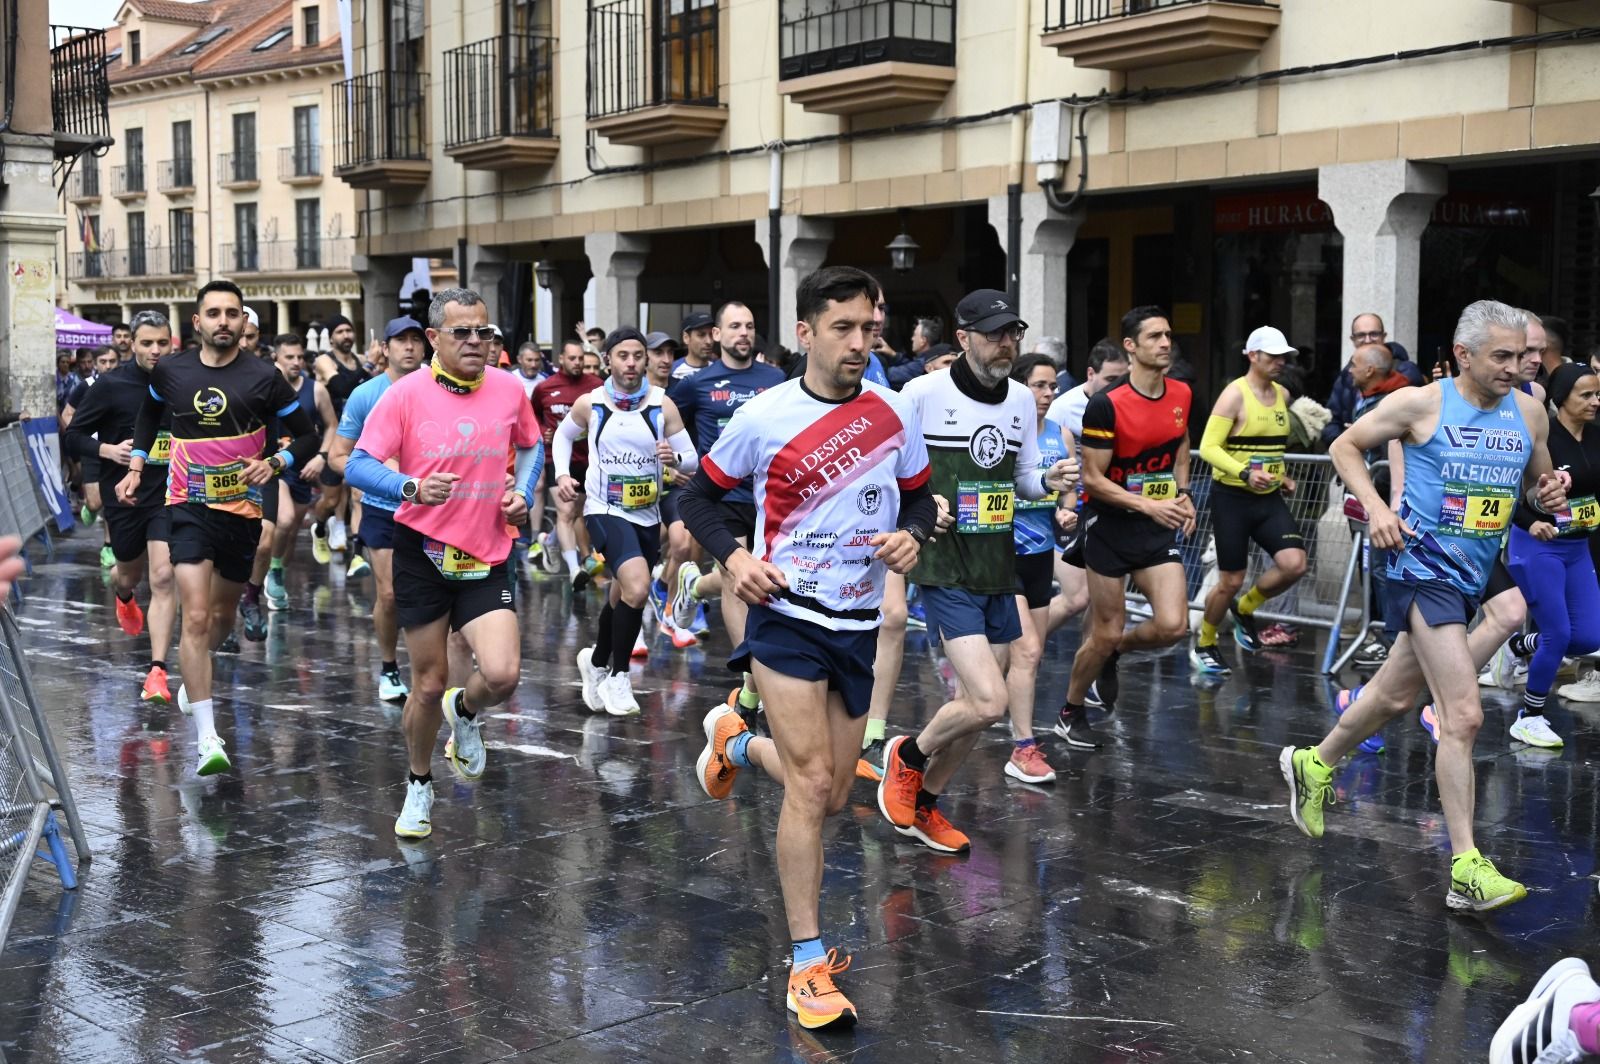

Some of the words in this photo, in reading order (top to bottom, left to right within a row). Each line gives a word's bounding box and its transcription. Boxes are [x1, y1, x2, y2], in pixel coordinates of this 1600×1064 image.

[55, 334, 113, 346] asport.es
[1484, 428, 1521, 438] COMERCIAL
[785, 468, 805, 485] LA
[801, 415, 874, 471] DESPENSA
[1485, 436, 1524, 454] ULSA
[601, 452, 657, 470] intelligent
[1439, 451, 1482, 460] SUMINISTROS
[212, 473, 239, 489] 369
[799, 480, 822, 502] DE
[816, 445, 872, 490] FER
[1440, 462, 1522, 484] ATLETISMO
[629, 485, 651, 497] 338
[1147, 483, 1169, 496] 349
[986, 494, 1009, 511] 202
[1480, 499, 1500, 517] 24
[1578, 505, 1596, 521] 264
[1475, 520, 1501, 529] Mariano
